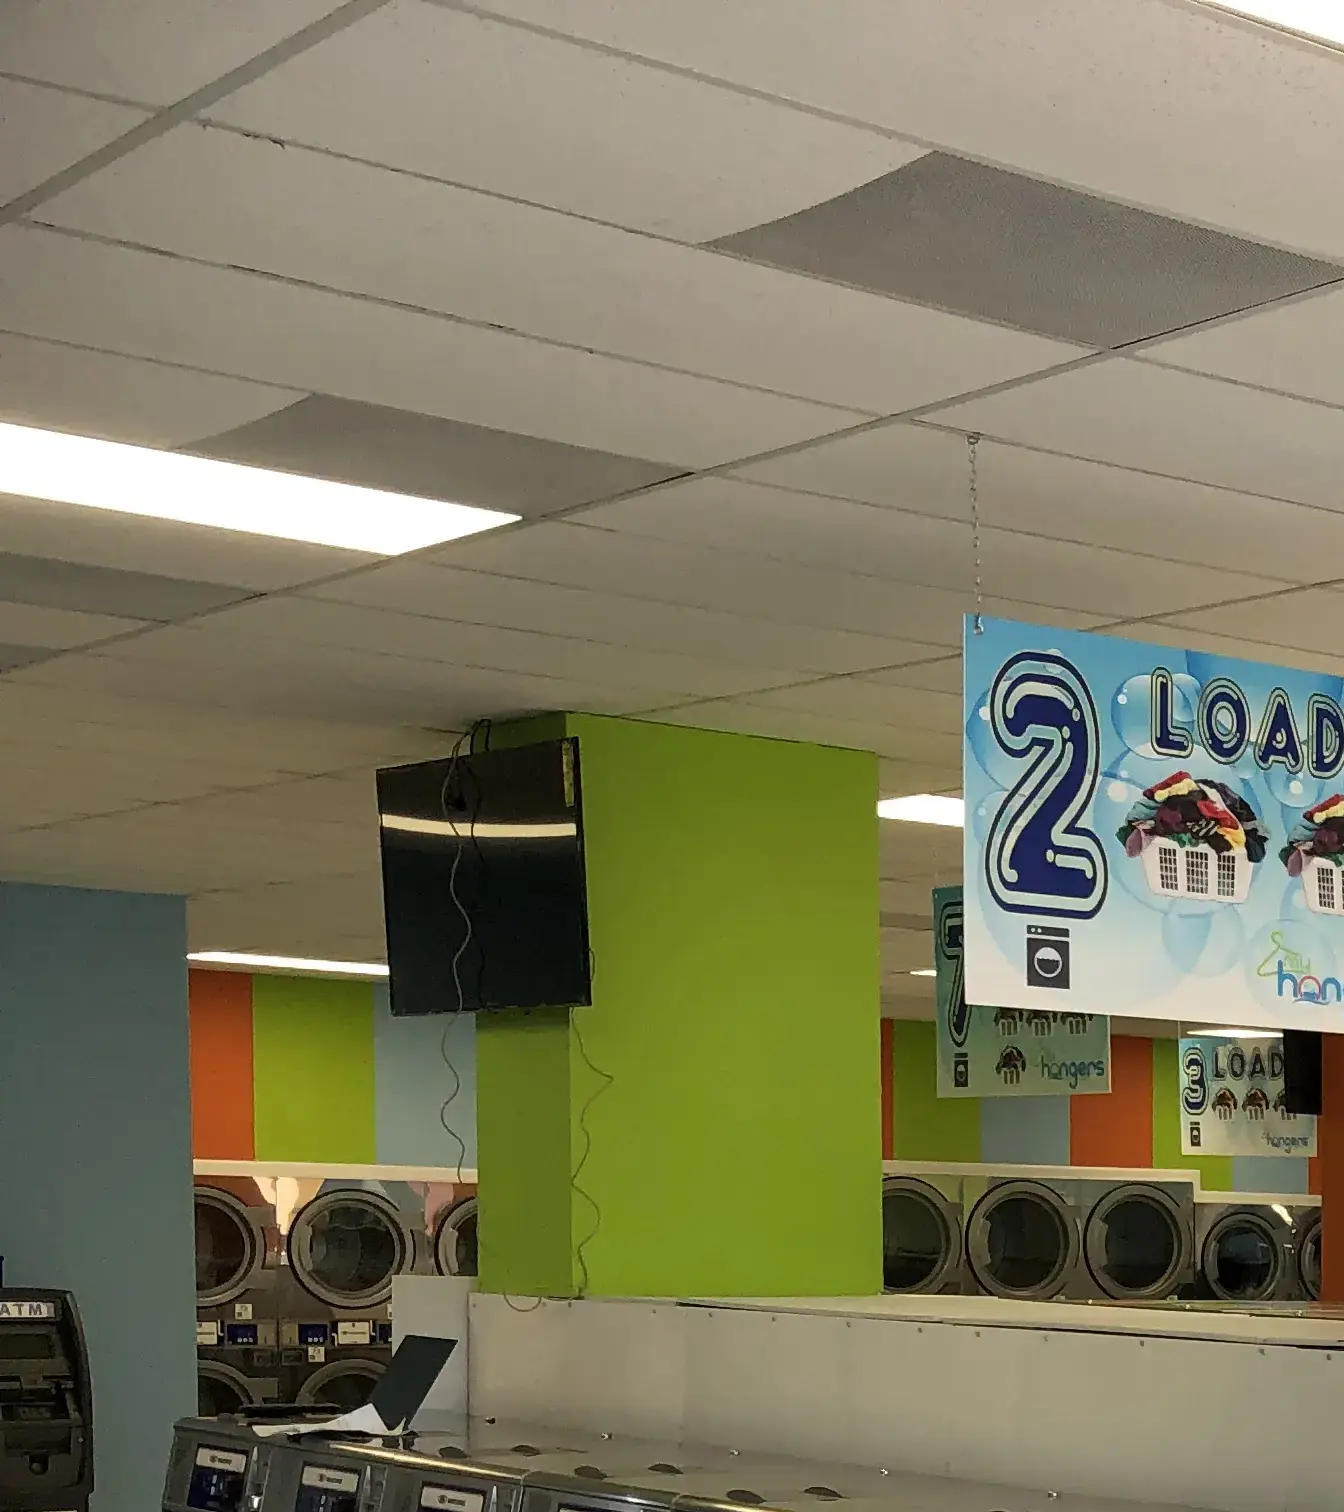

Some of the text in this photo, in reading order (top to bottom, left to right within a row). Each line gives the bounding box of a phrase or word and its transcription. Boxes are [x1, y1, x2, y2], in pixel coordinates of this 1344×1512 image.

[985, 648, 1108, 920] 2
[1040, 1054, 1105, 1090] hangers
[1182, 1045, 1285, 1115] 3 LOAD
[0, 1303, 43, 1316] ATM
